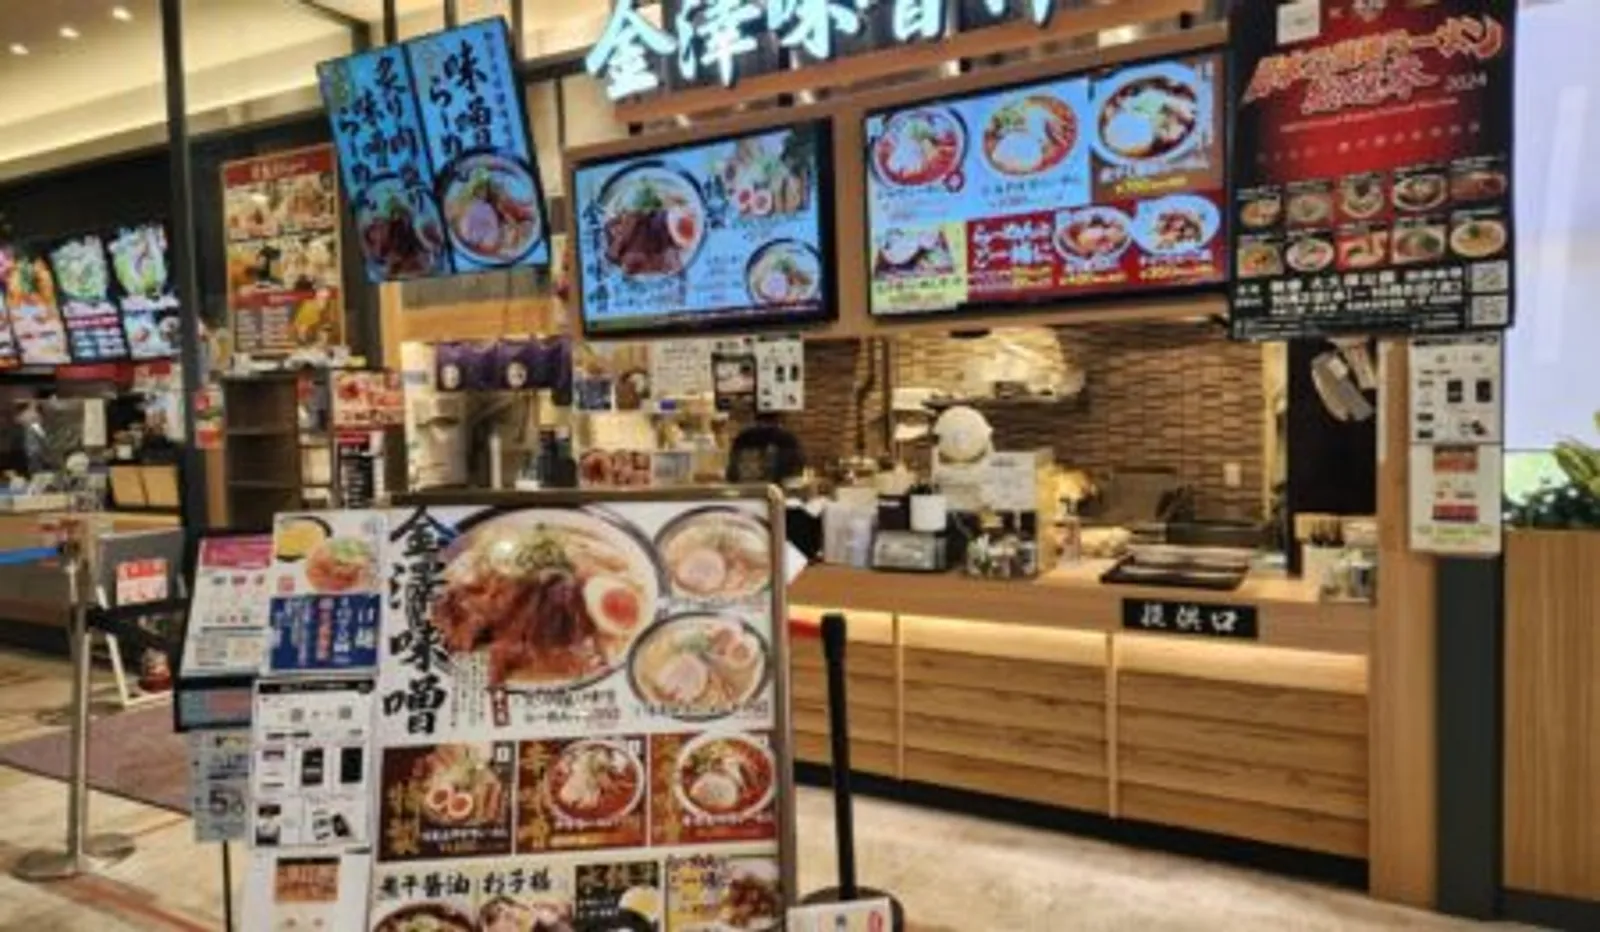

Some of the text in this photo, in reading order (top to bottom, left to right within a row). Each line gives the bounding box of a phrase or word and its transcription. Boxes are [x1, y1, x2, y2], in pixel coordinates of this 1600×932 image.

[443, 38, 492, 146] 味噌
[1445, 72, 1488, 91] 2024
[384, 504, 459, 736] 金澤味噌
[1140, 603, 1239, 631] 提供口
